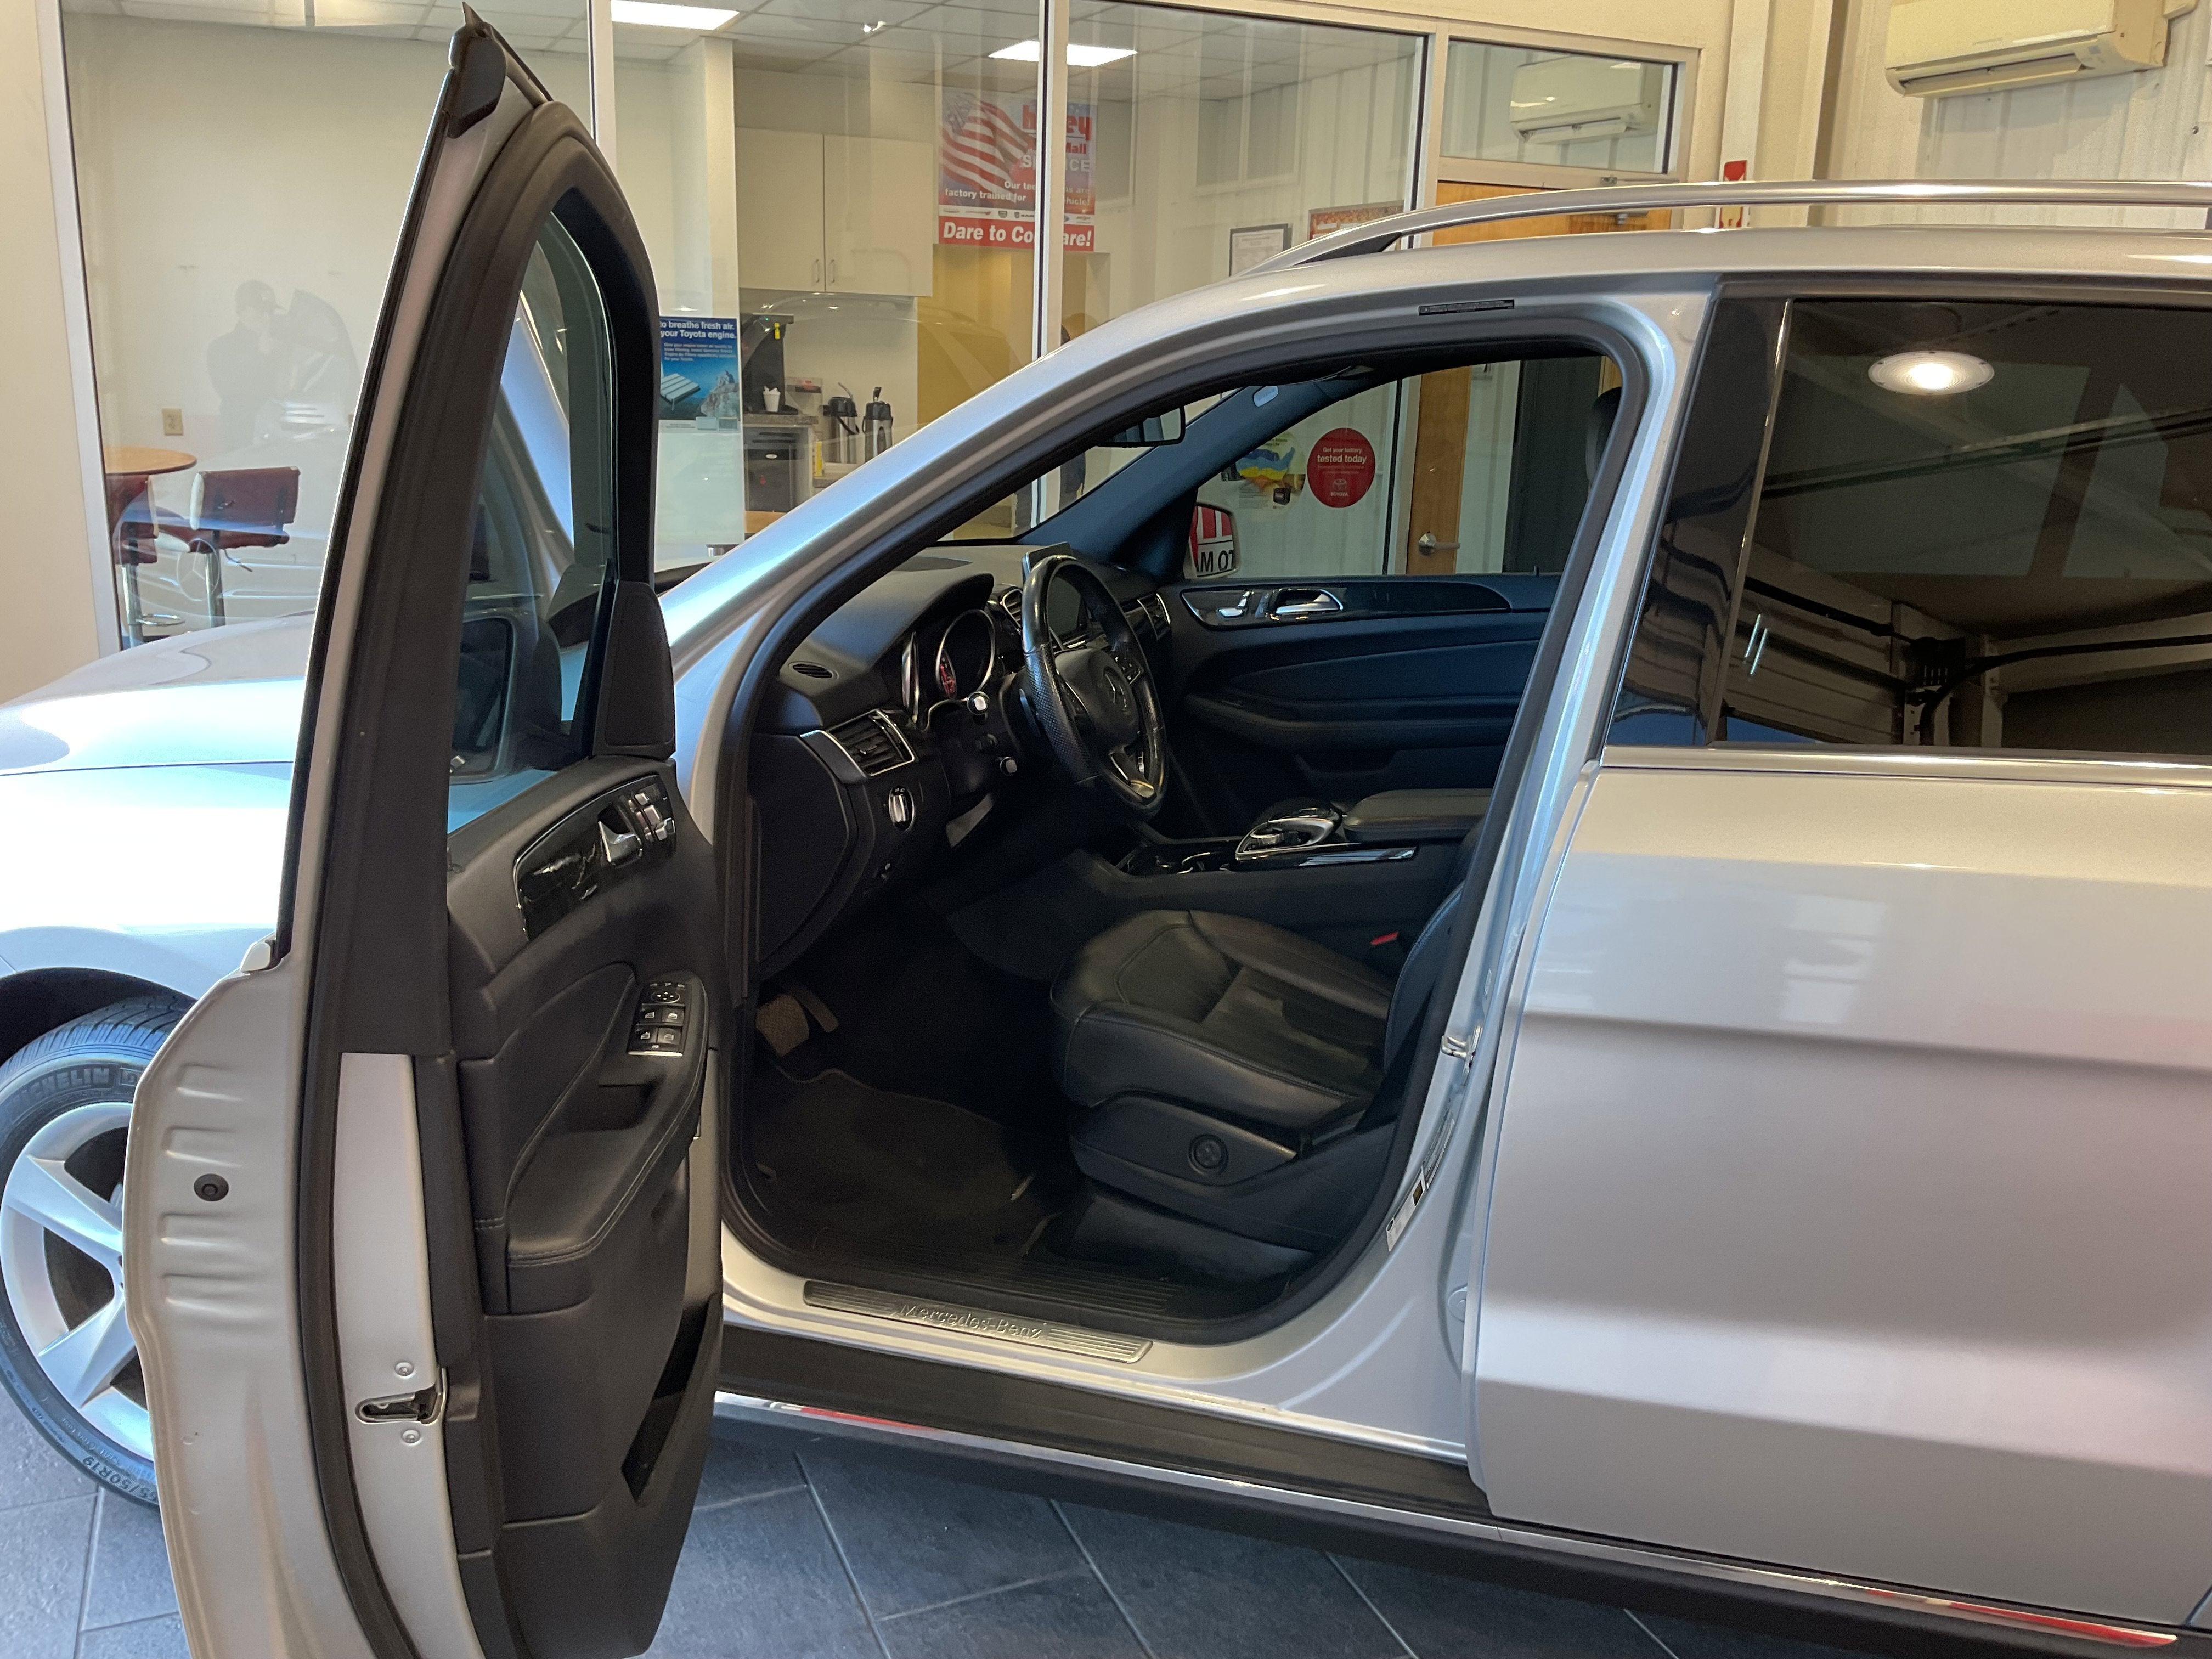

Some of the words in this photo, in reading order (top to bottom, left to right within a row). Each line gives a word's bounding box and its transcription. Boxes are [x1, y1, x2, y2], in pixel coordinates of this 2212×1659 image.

[1005, 181, 1021, 189] Our
[945, 188, 977, 199] factory
[980, 191, 1011, 200] trained
[1013, 193, 1026, 201] for
[943, 222, 984, 240] Dare
[989, 225, 1006, 241] to
[1012, 226, 1092, 247] Coare!
[679, 330, 706, 339] Toyota
[708, 331, 737, 340] engine.
[1345, 455, 1367, 465] today
[900, 1305, 1042, 1340] Mercedes-Benz
